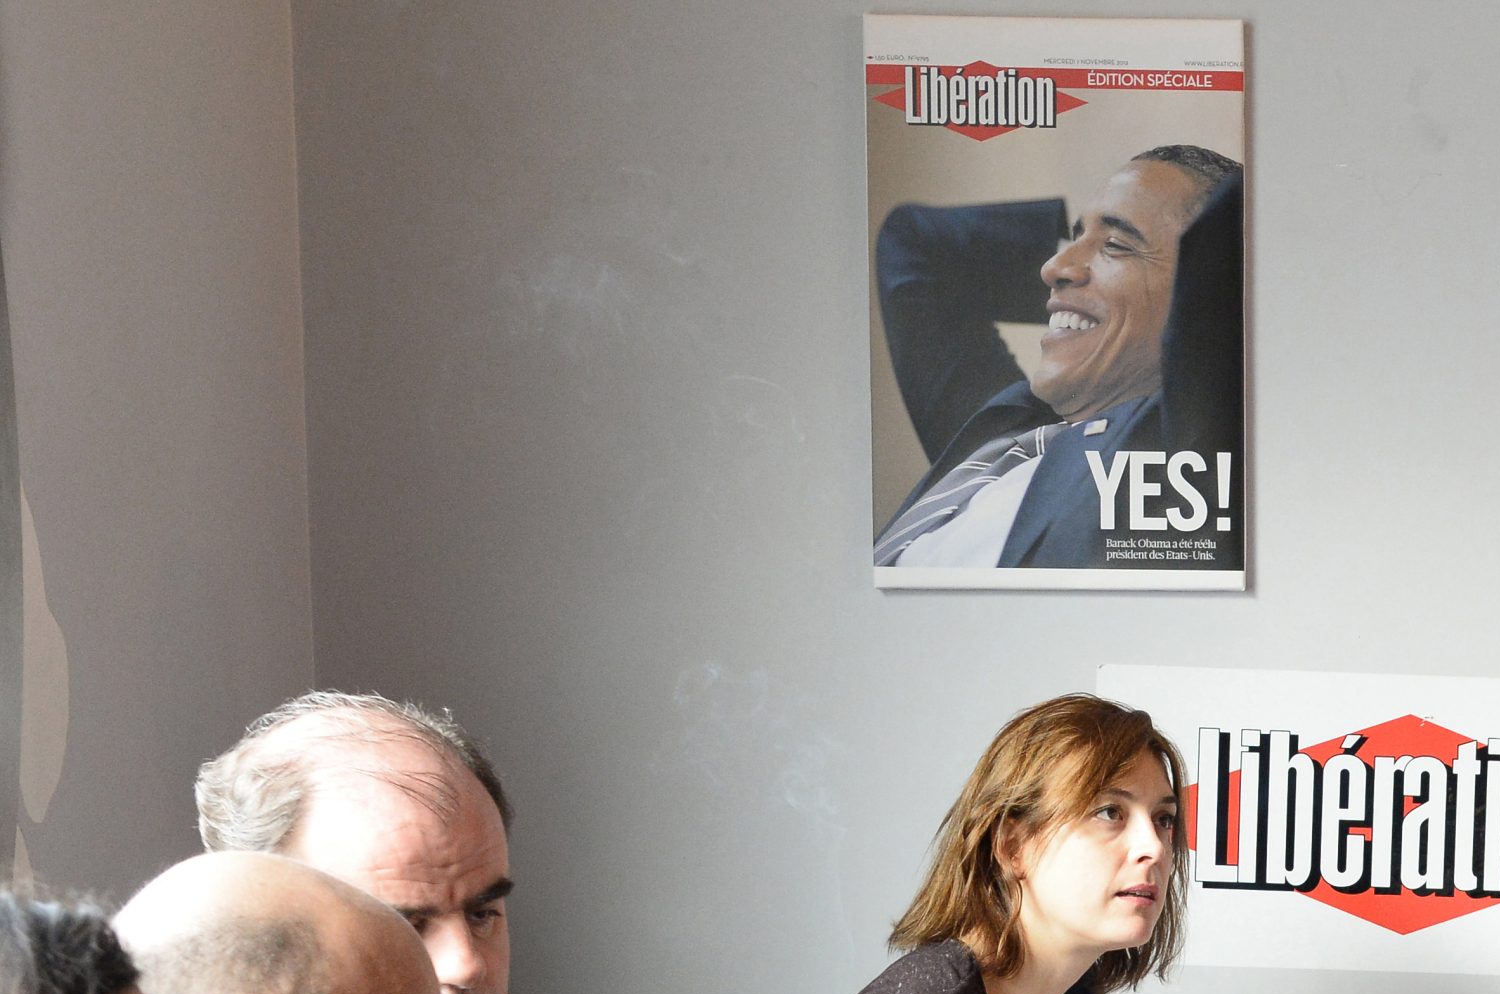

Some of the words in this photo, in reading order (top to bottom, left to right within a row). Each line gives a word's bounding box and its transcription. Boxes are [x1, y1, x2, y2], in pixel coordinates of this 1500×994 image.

[1080, 58, 1116, 66] NOVEMBRE
[1087, 69, 1144, 87] ÉDITION
[1147, 71, 1213, 88] SPÉCIALE
[904, 66, 1057, 129] Libération
[1085, 450, 1232, 532] YES!
[1106, 538, 1137, 548] Barack
[1138, 538, 1171, 549] Obama
[1172, 541, 1178, 549] a
[1179, 539, 1193, 549] été
[1194, 538, 1217, 549] réélu
[1106, 549, 1148, 561] président
[1148, 550, 1165, 559] des
[1166, 550, 1216, 560] Etats-Unis.
